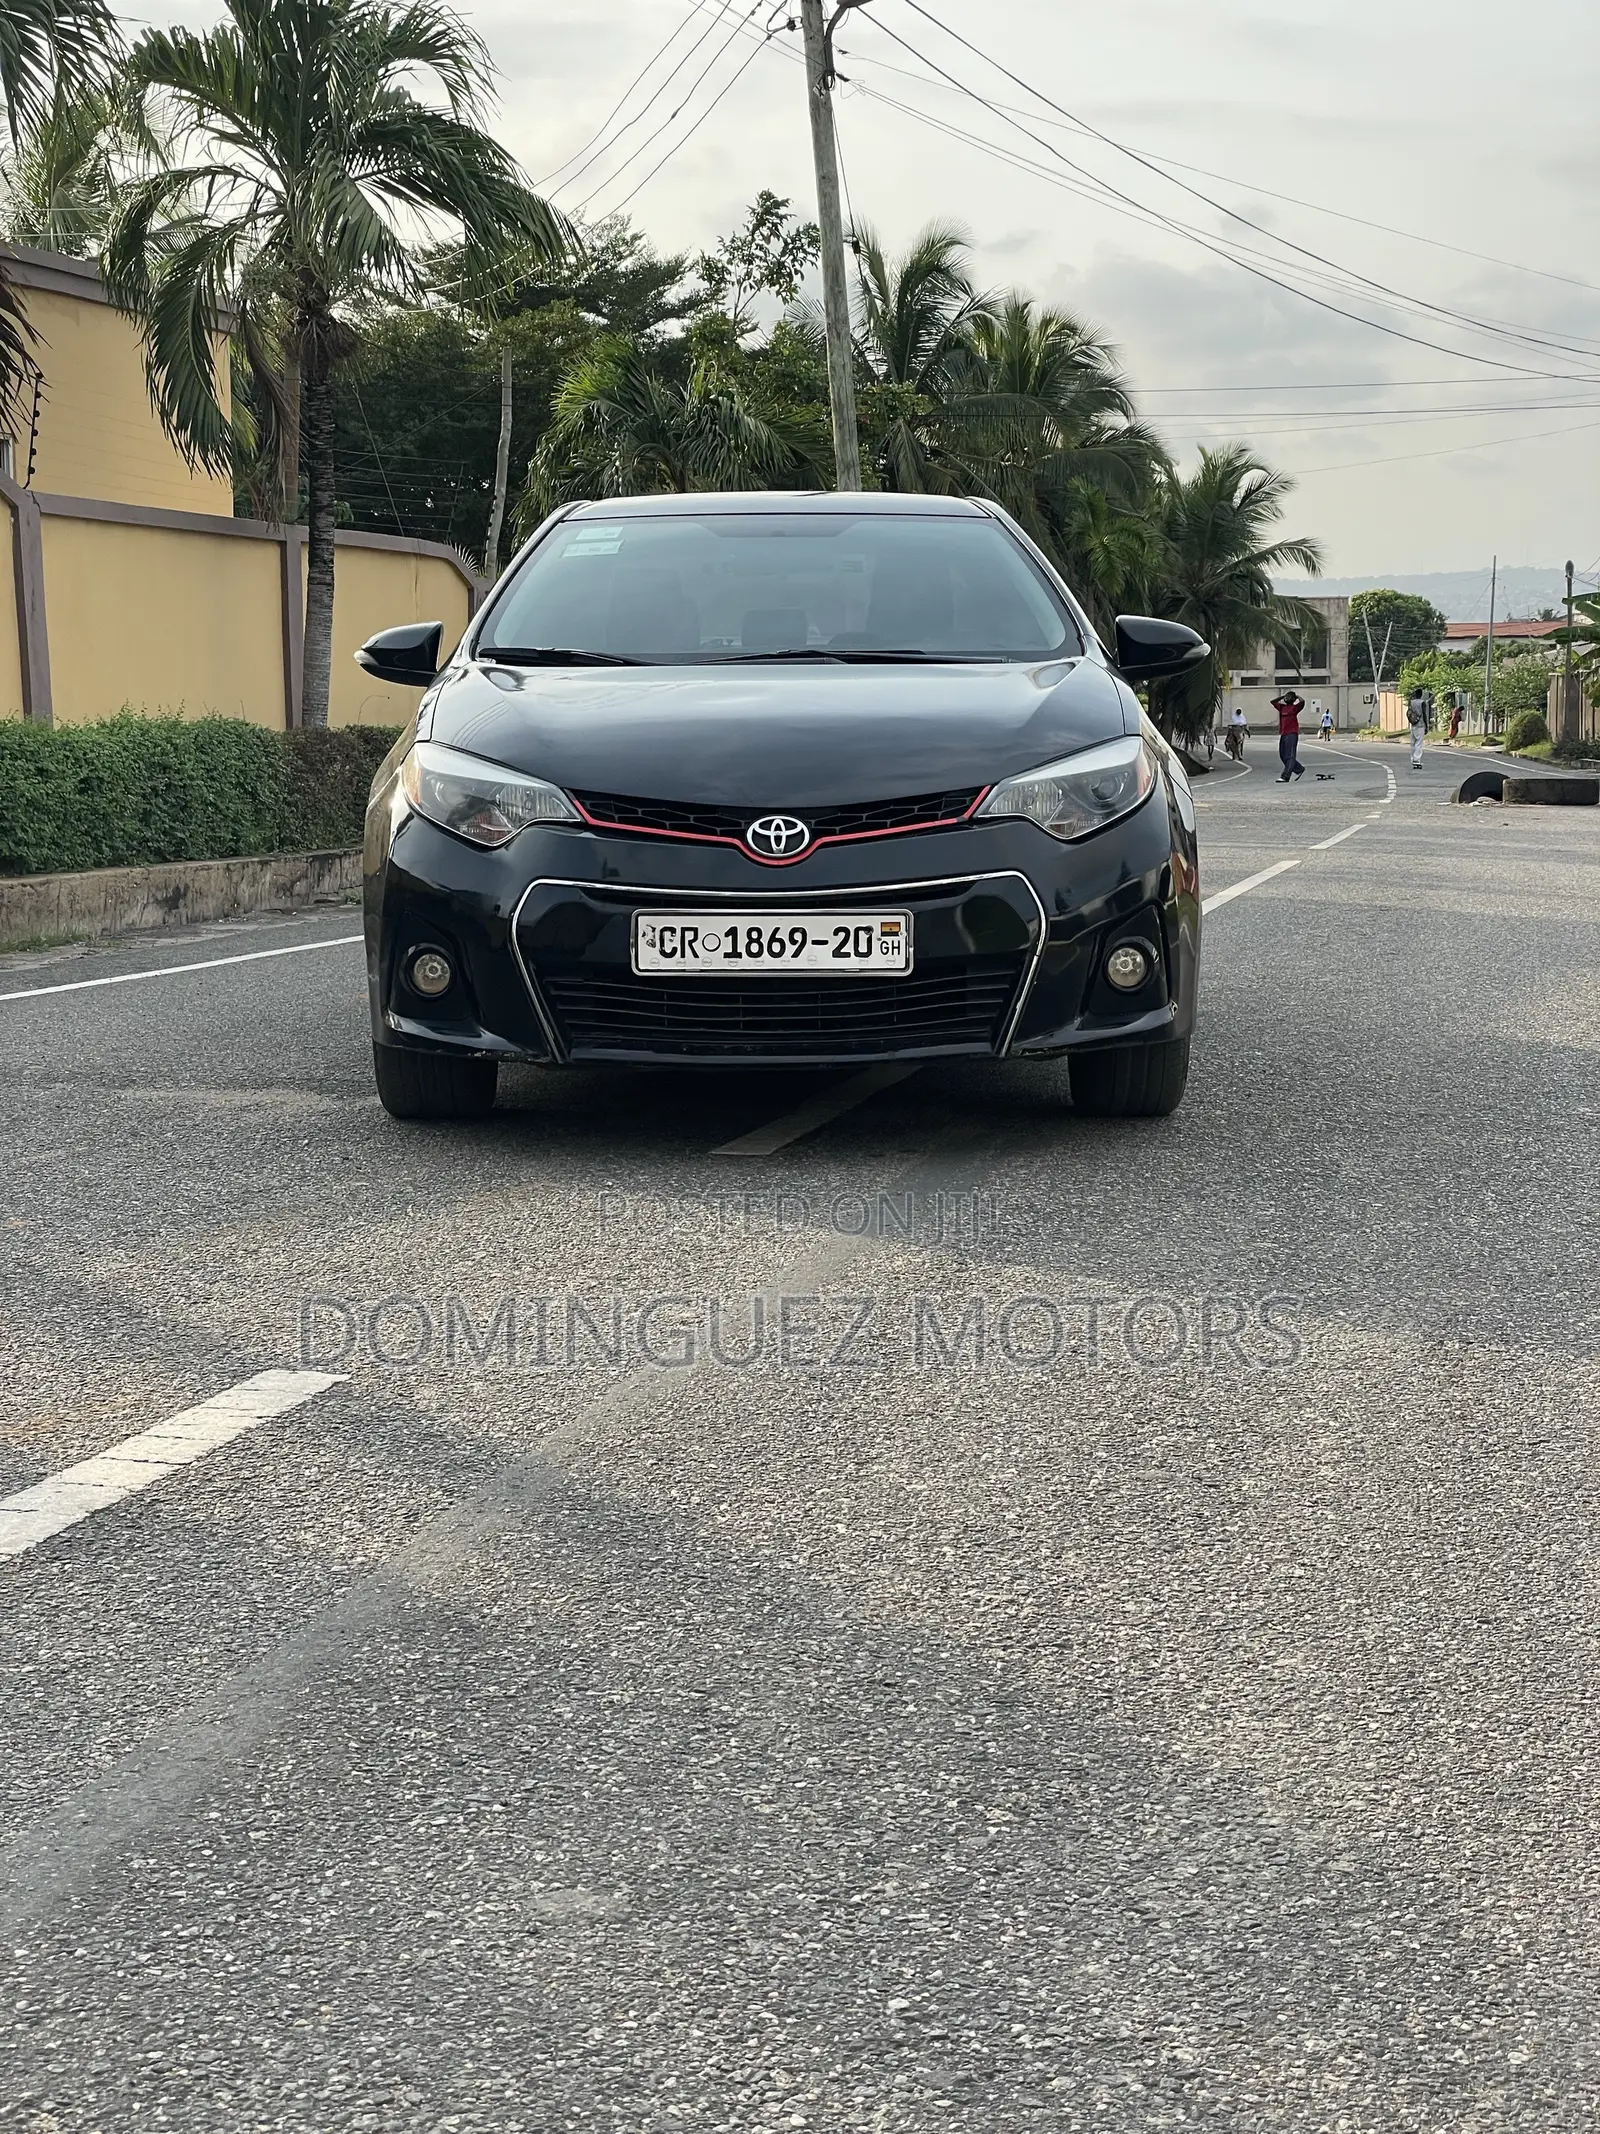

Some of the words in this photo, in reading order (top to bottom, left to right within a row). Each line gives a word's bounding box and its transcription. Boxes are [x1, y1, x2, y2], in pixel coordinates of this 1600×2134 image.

[659, 926, 700, 959] CR
[722, 926, 873, 959] 1869-20
[880, 940, 901, 956] GH
